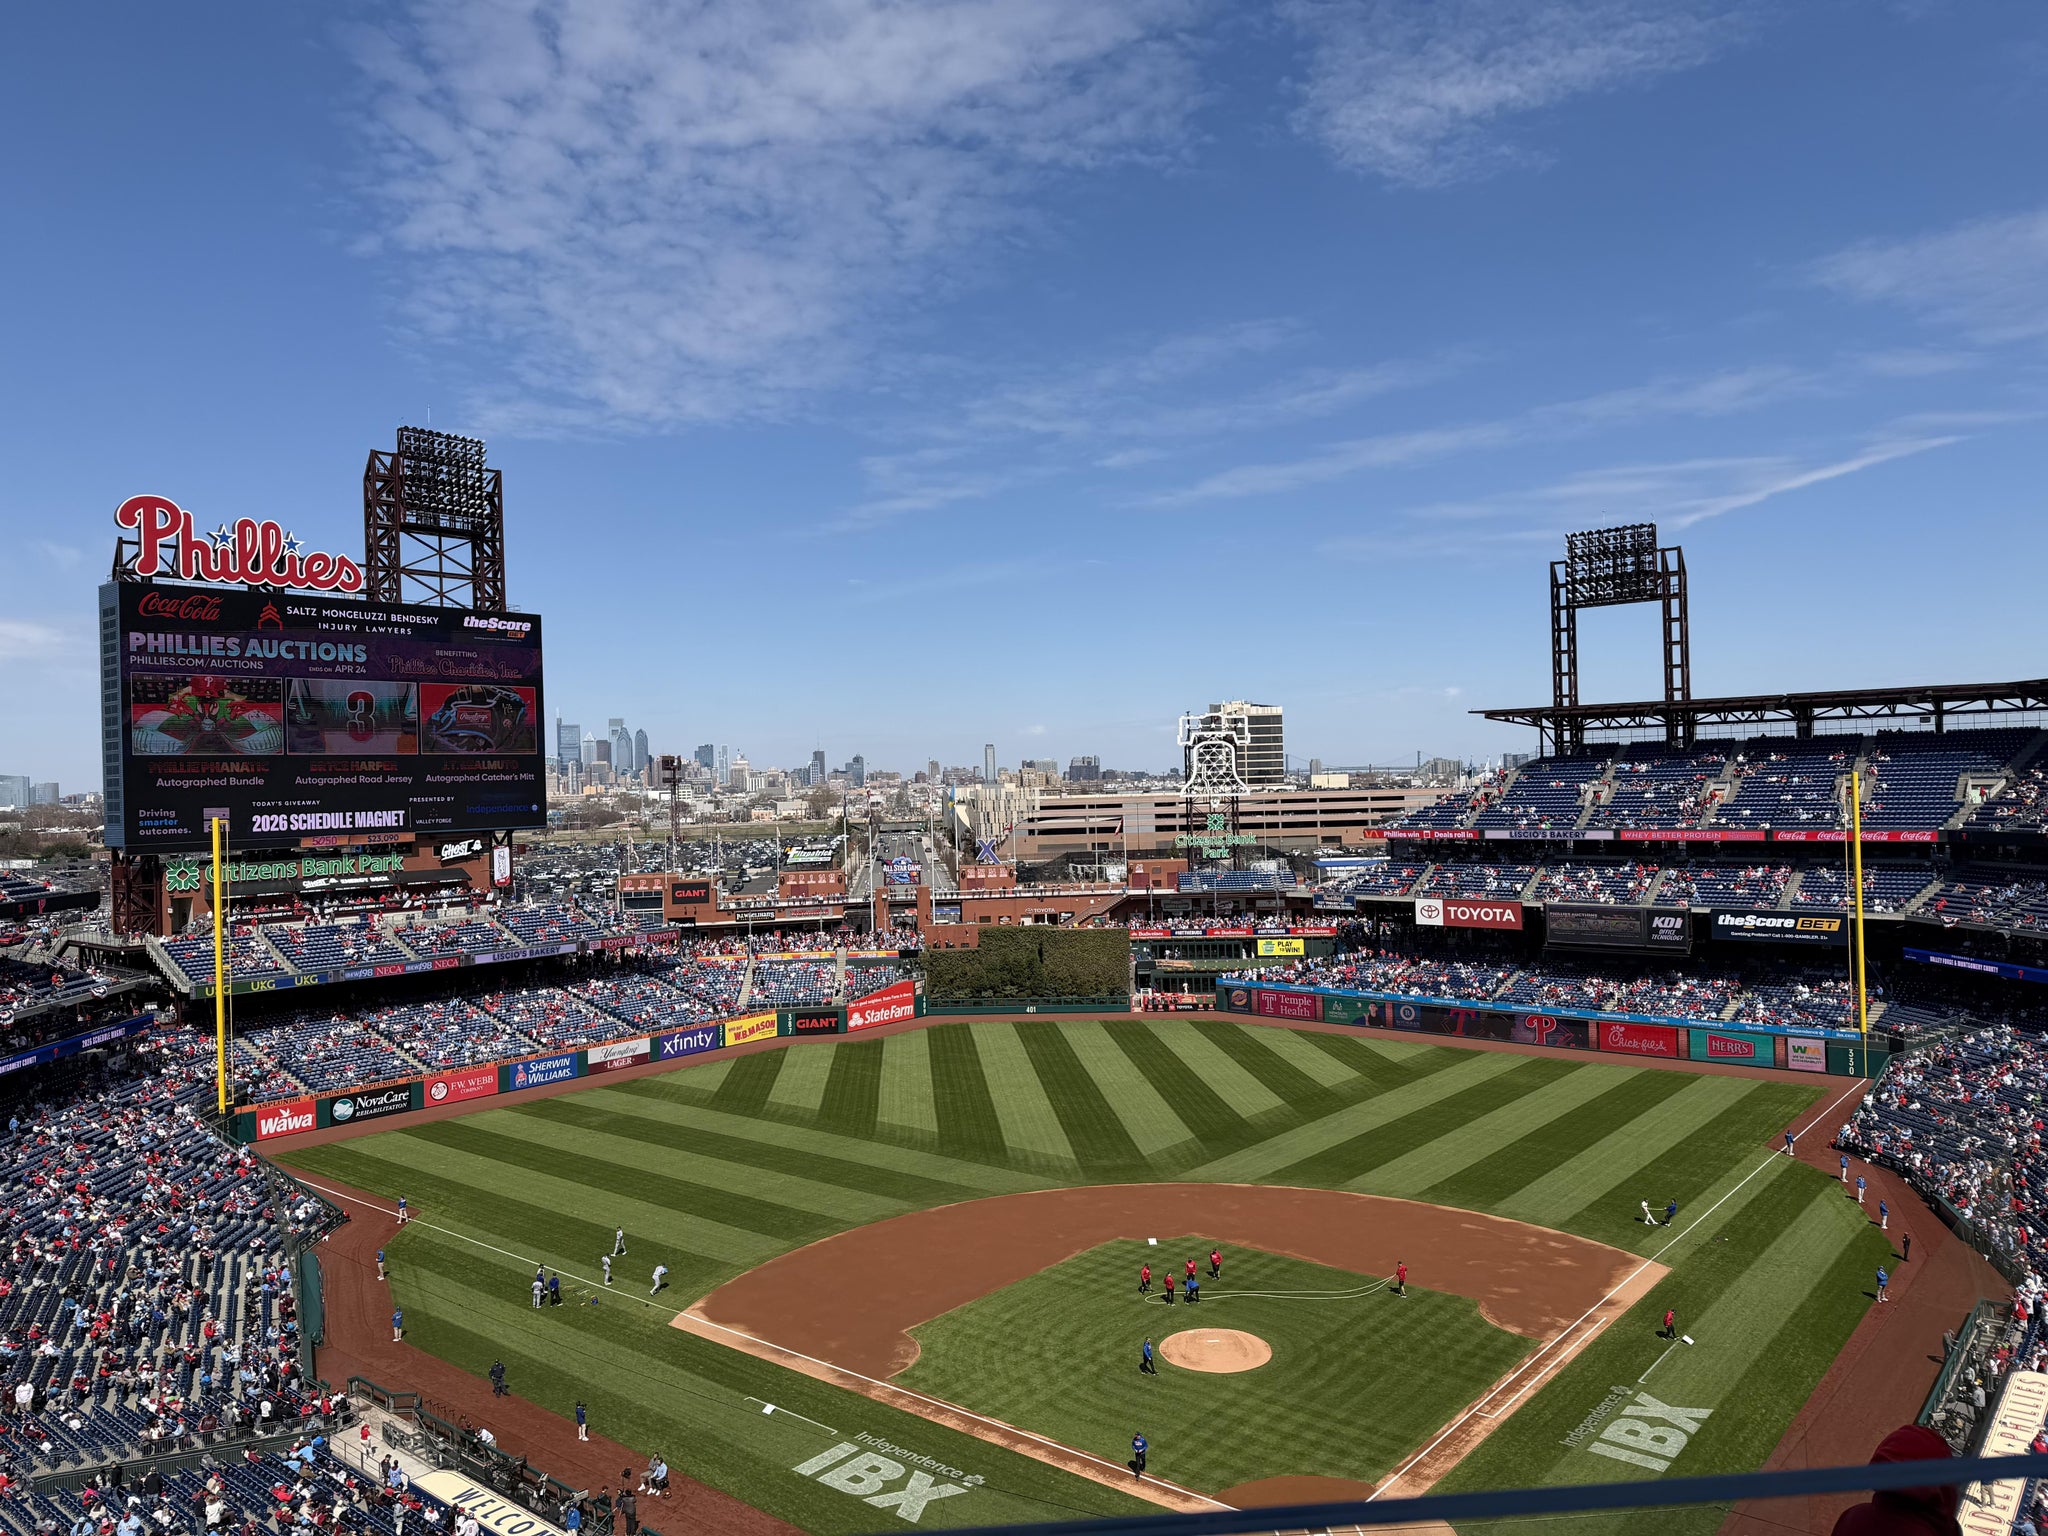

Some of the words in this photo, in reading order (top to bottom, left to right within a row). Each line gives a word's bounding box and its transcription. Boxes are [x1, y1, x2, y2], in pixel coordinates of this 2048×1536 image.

[116, 494, 363, 592] Phillies
[138, 591, 223, 621] Coca-Cola
[286, 606, 317, 617] SALTZ
[322, 608, 387, 622] MONGELUZZI
[391, 613, 439, 625] BENDESKY
[318, 622, 357, 632] INJURY
[366, 625, 412, 635] LAWYERS
[463, 616, 532, 631] theScore
[129, 631, 240, 658] PHILLIES
[245, 639, 367, 663] AUCTIONS
[435, 650, 478, 658] BENEFITTING
[130, 655, 264, 670] PHILLIES.COM/AUCTIONS
[334, 664, 355, 674] APR
[355, 665, 367, 674] 24
[347, 690, 376, 742] 3
[351, 761, 398, 772] HARPER
[156, 777, 227, 788] Autographed
[229, 776, 265, 785] Bundle
[295, 776, 357, 786] Autographed
[359, 775, 382, 783] Road
[385, 775, 413, 784] Jersey
[425, 773, 480, 783] Autographed
[481, 773, 518, 782] Catcher's
[519, 773, 535, 781] Mitt
[139, 809, 176, 818] Driving
[466, 804, 528, 814] Independence
[139, 818, 179, 827] smarter
[252, 814, 288, 832] 2026
[289, 811, 353, 831] SCHEDULE
[354, 810, 405, 828] MAGNET
[139, 826, 192, 836] outcomes.
[1383, 830, 1407, 838] Phillies
[367, 834, 399, 843] $23,090
[1175, 833, 1224, 847] Citizens
[1225, 832, 1257, 845] Bank
[441, 839, 474, 861] GHOST
[1202, 846, 1230, 858] Park
[205, 861, 298, 883] Citizens
[301, 855, 356, 877] Bank
[359, 851, 404, 873] Park
[883, 864, 893, 872] ALL
[893, 864, 907, 872] STAR
[907, 863, 922, 871] GAME
[675, 890, 706, 898] GIANT
[1447, 906, 1516, 923] TOYOTA
[1717, 914, 1796, 928] theScore
[1800, 919, 1837, 929] BET
[1652, 916, 1683, 929] KDI
[604, 938, 633, 947] TOYOTA
[649, 932, 678, 942] TOYOTA
[492, 950, 528, 962] LISCIO'S
[529, 946, 561, 958] BAKERY
[375, 965, 402, 976] NECA
[433, 958, 459, 969] NECA
[251, 979, 276, 991] UKG
[294, 974, 318, 986] UKG
[205, 985, 231, 997] UG
[1278, 994, 1312, 1007] Temple
[1279, 1005, 1310, 1017] Health
[796, 1017, 838, 1029] GIANT
[1450, 1007, 1476, 1036] T
[1688, 1020, 1719, 1028] Independence
[1786, 1028, 1819, 1036] Independence
[1525, 1014, 1556, 1045] P
[663, 1030, 714, 1054] xfinity
[1711, 1039, 1749, 1054] HERR'S
[600, 1044, 639, 1060] Yuengling
[1792, 1045, 1822, 1056] WM
[529, 1057, 571, 1073] SHERWIN
[607, 1057, 633, 1069] LAGER
[256, 1097, 301, 1110] ASPLUNDH
[309, 1088, 351, 1101] ASPLUNDH
[358, 1079, 399, 1092] ASPLUNDH
[405, 1071, 444, 1083] ASPLUNDH
[450, 1063, 487, 1075] ASPLUNDH
[493, 1056, 529, 1067] ASPLUNDH
[534, 1049, 568, 1059] ASPLUNDH
[450, 1081, 466, 1091] F.W.
[468, 1075, 494, 1088] WEBB
[460, 1086, 484, 1095] COMPANY
[355, 1090, 409, 1110] NovaCare
[355, 1102, 408, 1118] REHABILITATION
[260, 1113, 313, 1136] Wawa
[1559, 1391, 1622, 1448] Independence
[1587, 1391, 1714, 1473] IBX
[853, 1431, 963, 1480] Independence
[791, 1441, 969, 1524] IBX
